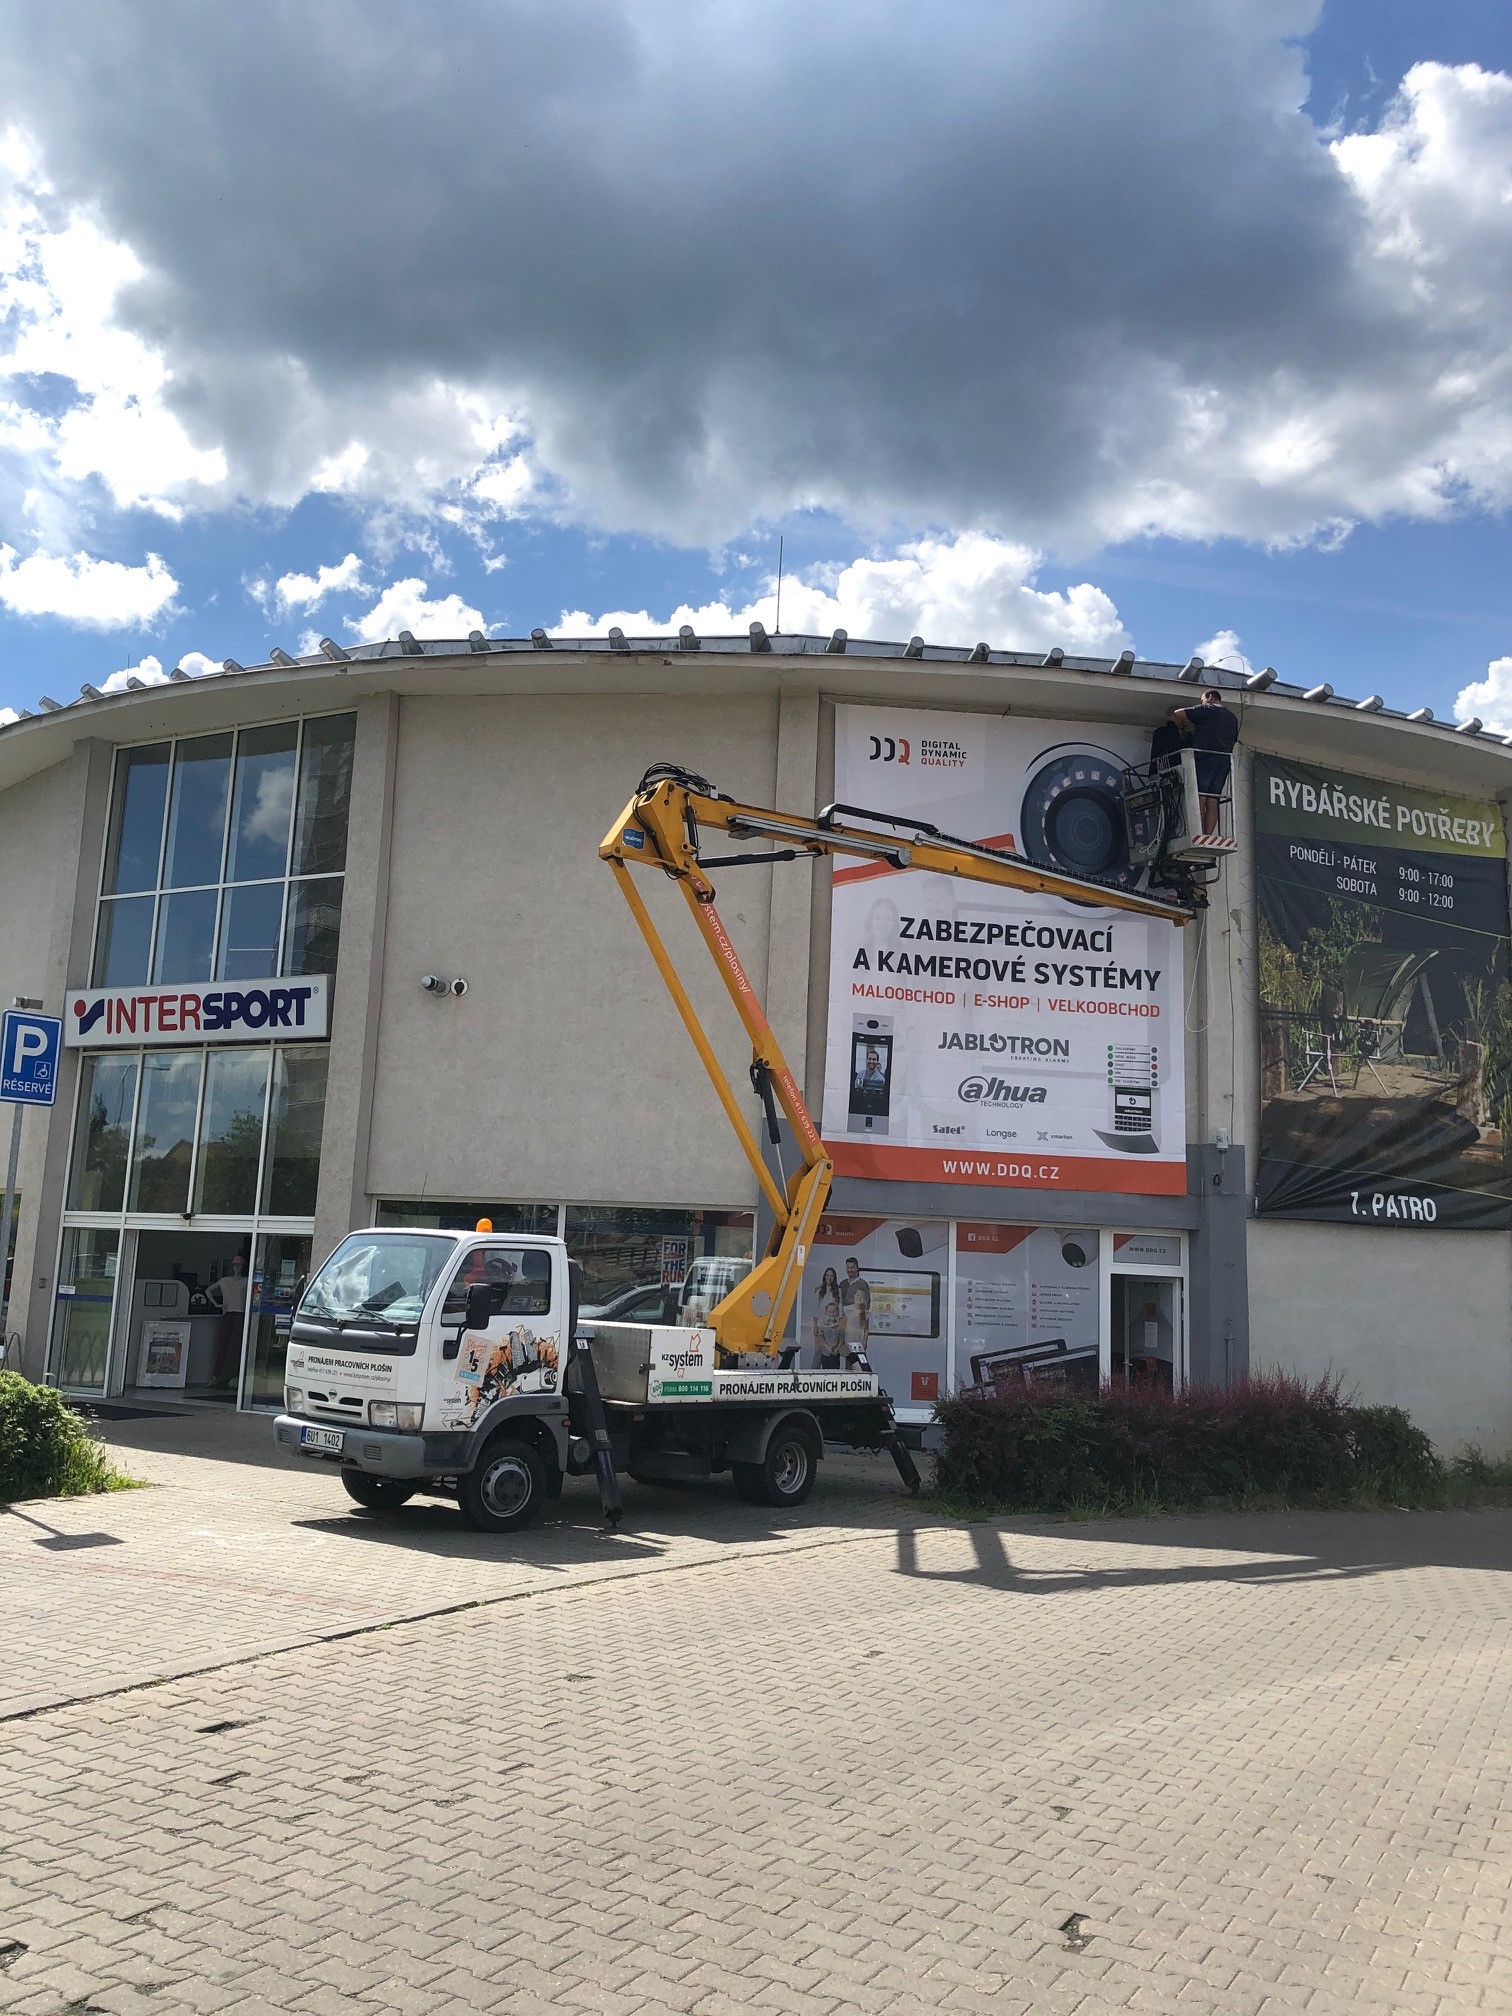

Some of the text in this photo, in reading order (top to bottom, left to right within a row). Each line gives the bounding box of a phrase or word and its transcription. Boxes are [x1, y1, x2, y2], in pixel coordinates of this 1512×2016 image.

[921, 740, 961, 750] DIGITAL
[921, 749, 967, 759] DYNAMIC
[921, 758, 965, 768] QUALITY
[1269, 776, 1495, 848] RYBÁŘSKÉ POTŘEBY
[1289, 845, 1335, 867] PONDĚLÍ
[1343, 855, 1377, 874] PÁTEK
[1398, 866, 1420, 882] 9:00
[1428, 872, 1454, 888] 17:00
[1336, 876, 1377, 896] SOBOTA
[1398, 888, 1420, 903] 9:00
[1428, 894, 1454, 909] 12:00
[899, 916, 1114, 953] ZABEZPEČOVACÍ
[852, 948, 1162, 992] A KAMEROVÉ SYSTÉMY
[851, 982, 1161, 1018] MALOOBCHOD E-SHOP VELKOOBCHOD
[106, 986, 312, 1034] INTERSPORT
[12, 1024, 49, 1074] P
[938, 1031, 1070, 1057] JABLOTRON
[2, 1076, 52, 1095] RÉSERVÉ
[980, 1100, 1024, 1109] TECHNOLOGY
[795, 1102, 804, 1114] 417
[801, 1115, 811, 1129] 639
[807, 1129, 816, 1142] 221
[986, 1128, 1018, 1140] Longse
[942, 1160, 1060, 1180] WWW.DDQ.CZ
[1372, 1193, 1437, 1222] PATRO
[664, 1241, 687, 1254] FOR
[663, 1260, 686, 1271] THE
[662, 1270, 686, 1283] RUN
[307, 1355, 393, 1373] PRONÁJEM PRACOVNÍCH PLOŠIN
[719, 1378, 872, 1396] PRONÁJEM PRACOVNÍCH PLOŠIN
[306, 1430, 340, 1447] 6U1 1402
